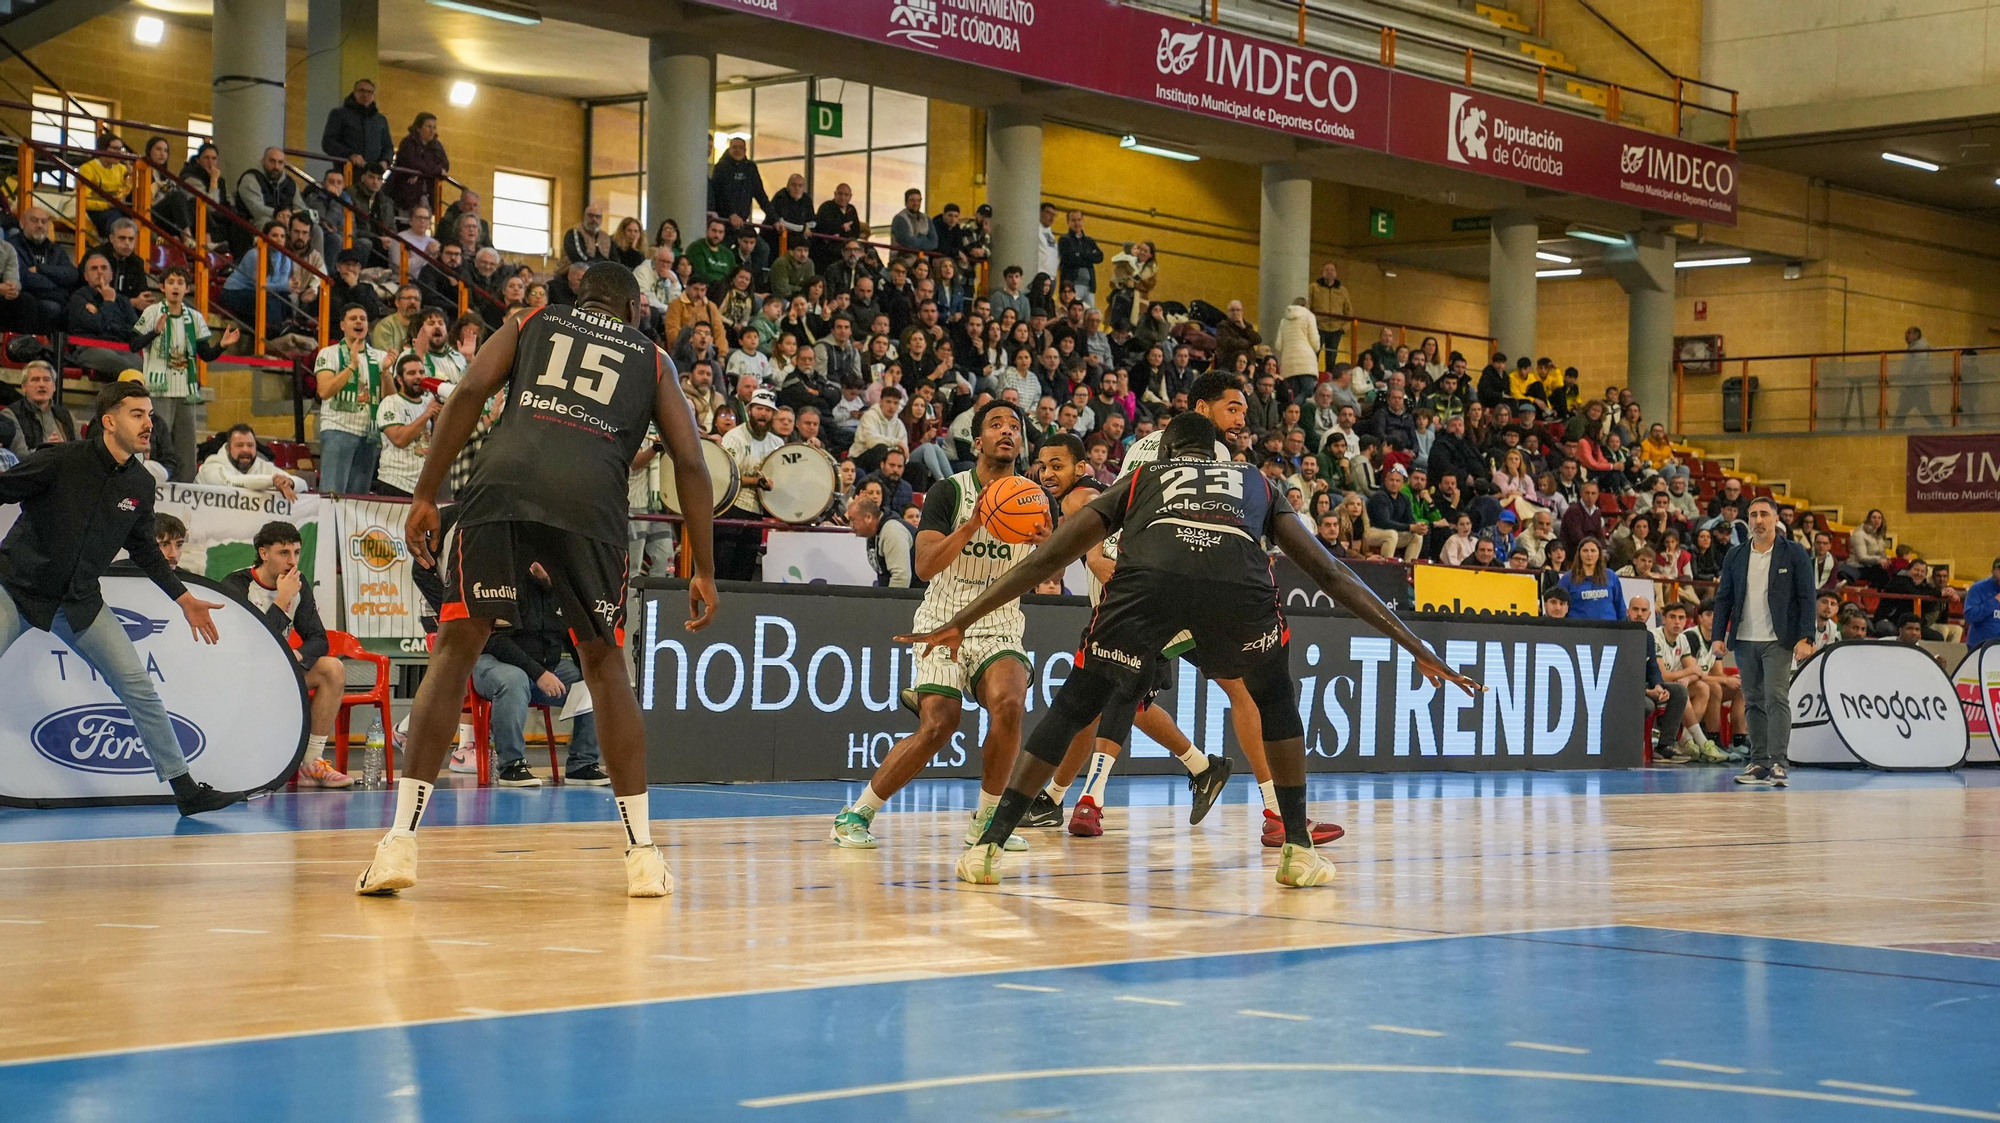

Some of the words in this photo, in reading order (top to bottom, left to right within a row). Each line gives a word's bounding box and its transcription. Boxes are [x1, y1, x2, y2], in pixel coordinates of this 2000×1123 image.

[941, 0, 1035, 26] UNTAMIENTO
[941, 12, 959, 38] DE
[960, 15, 1021, 53] CÓRDOBA
[1205, 34, 1358, 113] IMDECO
[819, 106, 833, 131] D
[1156, 83, 1199, 106] Instituto
[1201, 94, 1250, 119] Municipal
[1252, 105, 1266, 121] de
[1268, 108, 1313, 131] Deportes
[1314, 118, 1355, 140] Córdoba
[1494, 118, 1563, 153] Diputación
[1493, 147, 1509, 165] de
[1512, 149, 1563, 176] Córdoba
[1647, 147, 1733, 195] IMDECO
[1378, 212, 1387, 233] E
[536, 332, 625, 406] 15
[781, 452, 803, 466] NP
[169, 484, 260, 511] Leyendas
[263, 494, 292, 516] del
[1159, 466, 1244, 504] 23
[1917, 490, 1959, 501] Instituto
[360, 580, 398, 597] PEÑA
[350, 602, 409, 616] OFICIAL
[1091, 641, 1142, 670] fundibide
[70, 714, 151, 761] For
[847, 731, 967, 769] HOLS
